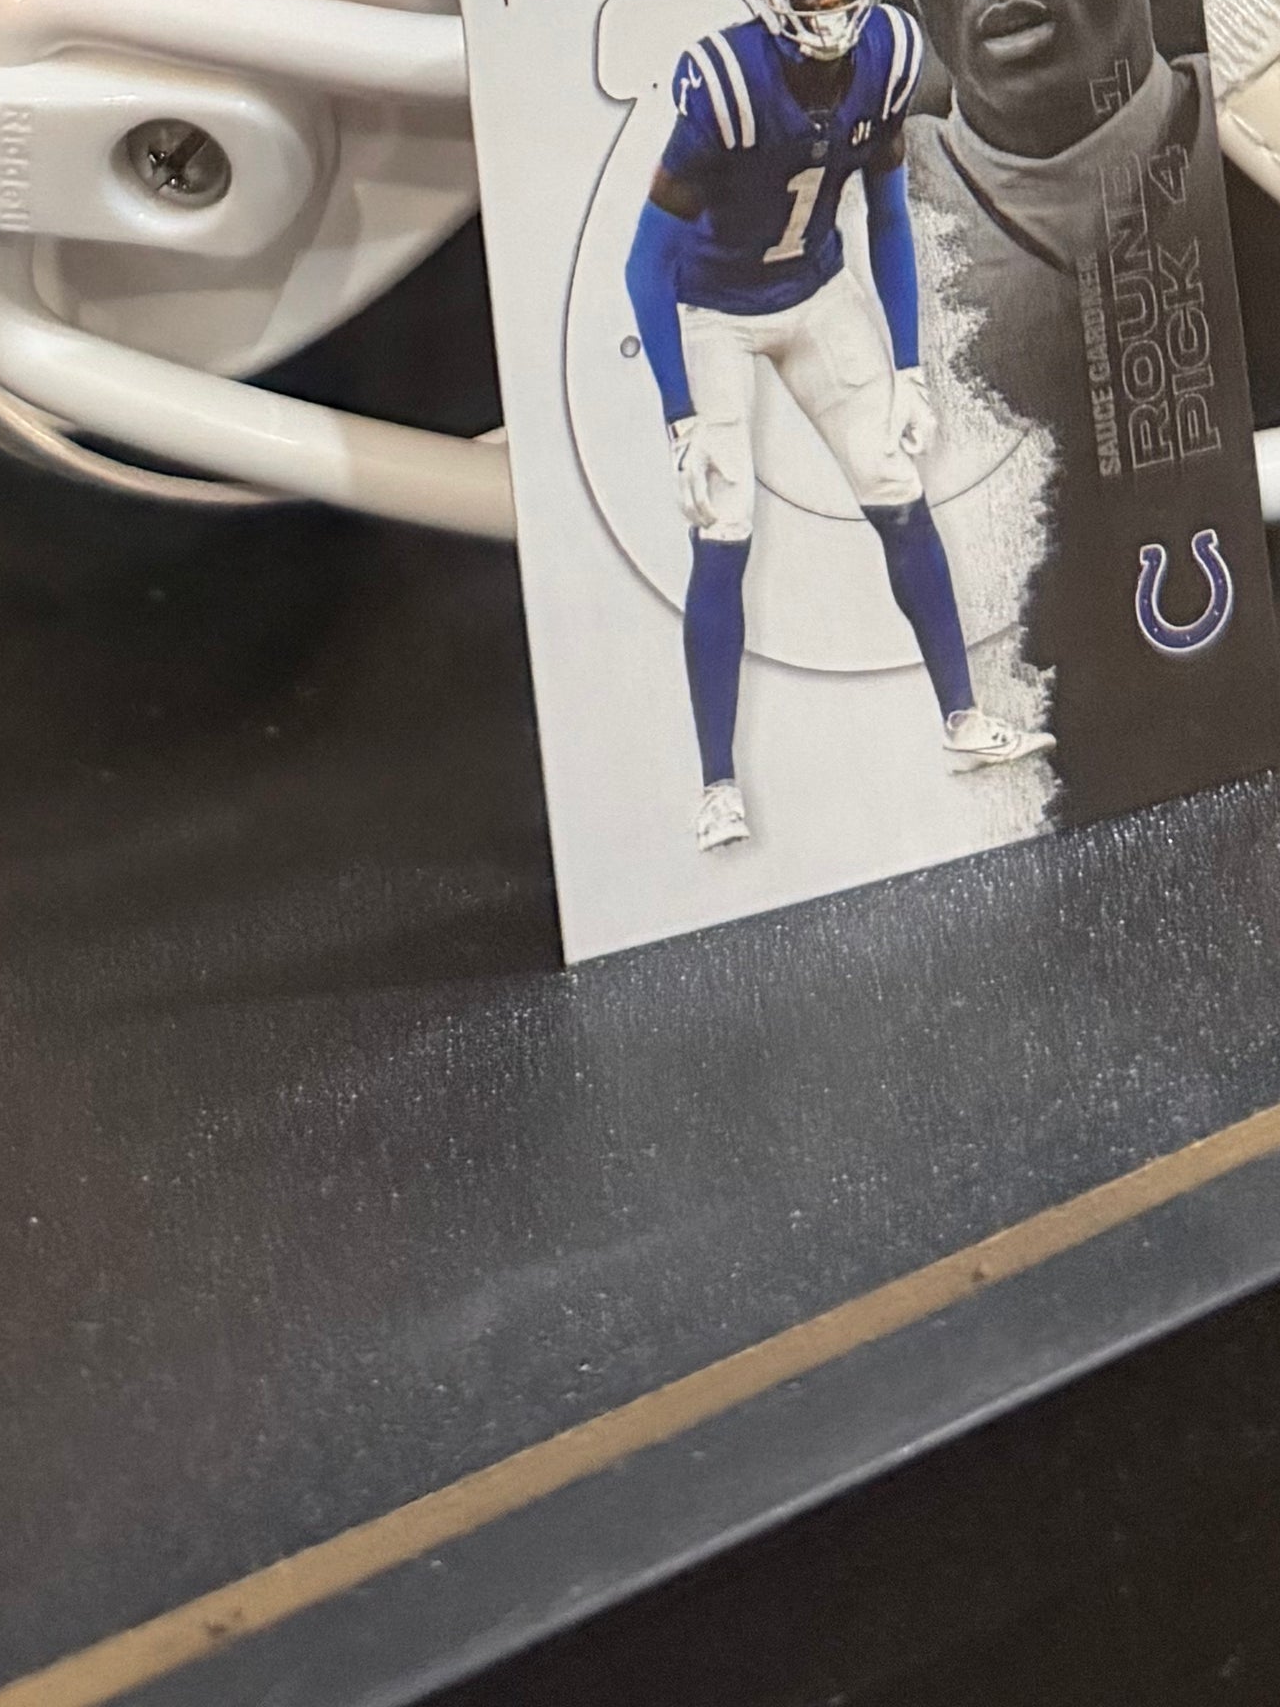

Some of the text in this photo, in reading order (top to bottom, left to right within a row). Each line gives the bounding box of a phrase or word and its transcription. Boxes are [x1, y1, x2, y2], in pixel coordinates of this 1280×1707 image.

[762, 165, 826, 265] 1
[1099, 149, 1174, 469] ROUND
[1147, 143, 1221, 460] PICK 4
[1078, 252, 1122, 476] SAUCE GARDNER
